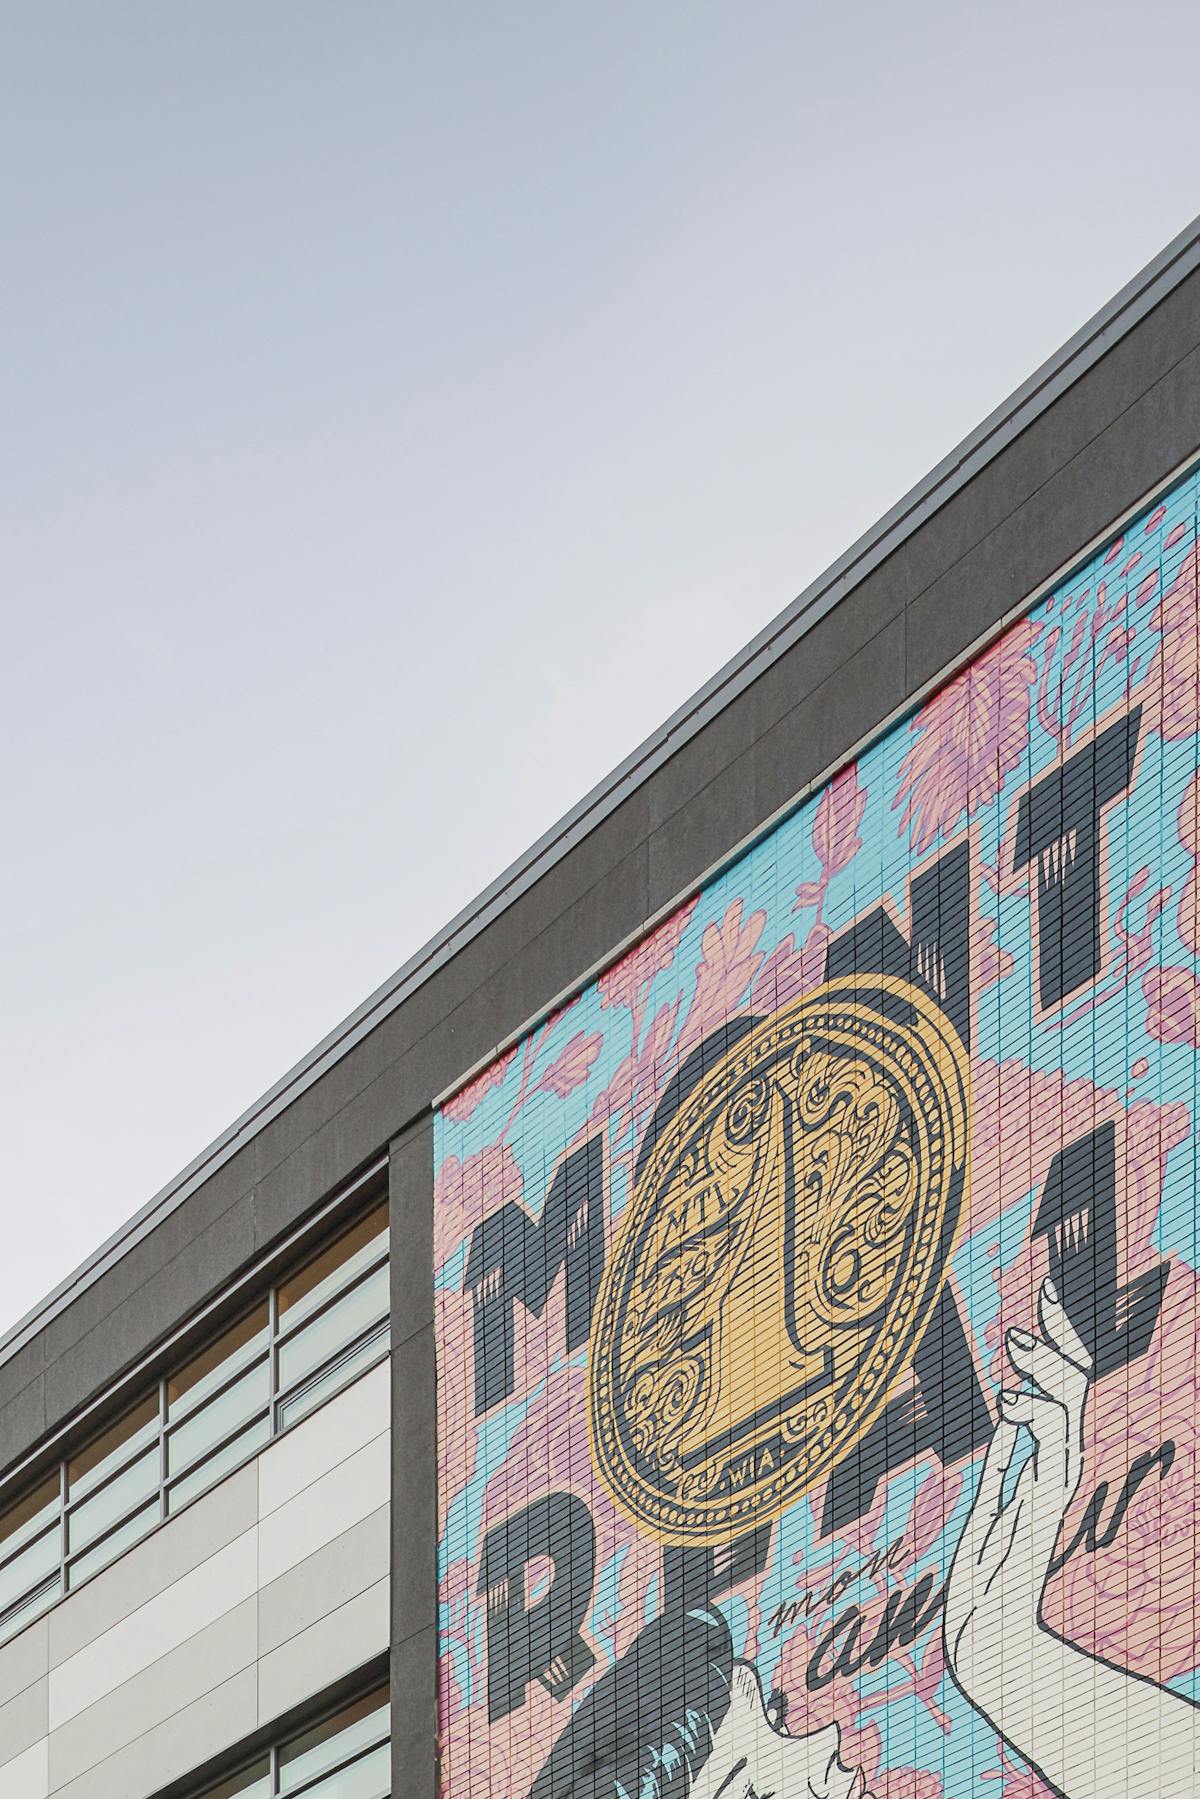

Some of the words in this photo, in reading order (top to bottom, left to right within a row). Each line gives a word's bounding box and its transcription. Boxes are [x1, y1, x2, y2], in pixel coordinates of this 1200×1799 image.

[464, 703, 1144, 1416] MNT
[476, 1119, 1170, 1725] RAL
[728, 1448, 776, 1488] WIA
[767, 1537, 911, 1637] mon
[805, 1440, 1175, 1691] amur
